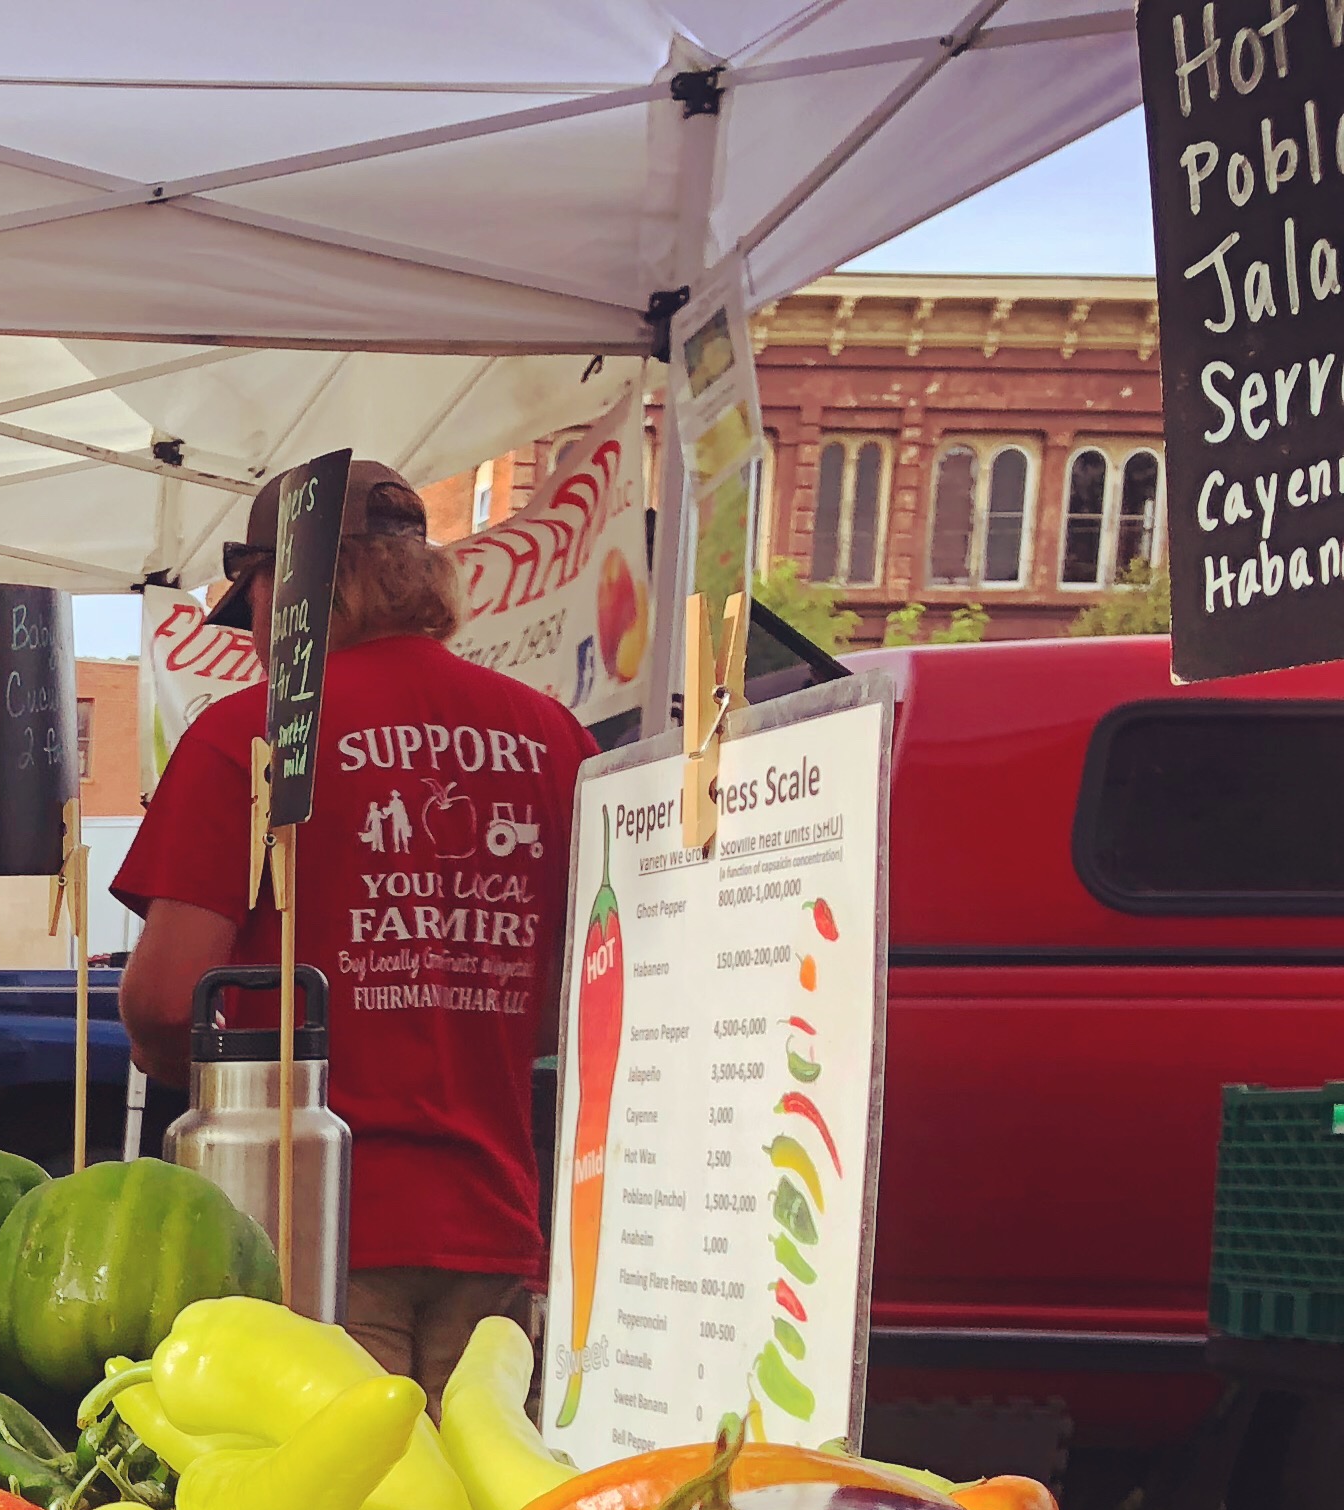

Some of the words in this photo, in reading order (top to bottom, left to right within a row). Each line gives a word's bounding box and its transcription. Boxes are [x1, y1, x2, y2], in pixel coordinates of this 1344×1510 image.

[1172, 0, 1298, 117] Hot
[1184, 217, 1341, 333] Jala
[1201, 353, 1344, 443] Serr
[1204, 537, 1344, 614] Haban
[292, 637, 315, 701] $1
[18, 726, 35, 770] 2
[338, 722, 548, 773] SUPPORT
[616, 798, 675, 845] Pepper
[765, 755, 821, 807] Scale
[720, 838, 756, 858] Scoville
[785, 826, 811, 845] units
[813, 812, 844, 843] (SHU)
[726, 861, 753, 879] function
[753, 861, 762, 873] of
[762, 857, 792, 875] capsaicin
[792, 845, 844, 867] concentration)
[361, 871, 445, 899] YOUR
[636, 902, 659, 919] Ghost
[659, 899, 687, 918] Pepper
[718, 878, 801, 909] 800,000-1,000,000
[349, 906, 540, 948] FARMERS
[369, 948, 420, 979] Locally
[586, 936, 616, 985] HOT
[633, 959, 670, 978] Habanero
[716, 944, 791, 970] 150,000-200,000
[630, 1025, 659, 1042] Serrano
[660, 1024, 690, 1043] Pepper
[714, 1017, 767, 1040] 4,500-6,000
[628, 1065, 661, 1086] Jalapeño
[711, 1062, 765, 1083] 3,500-6,500
[626, 1107, 659, 1126] Cayenne
[709, 1106, 734, 1127] 3,000
[575, 1146, 604, 1185] Mild
[624, 1148, 637, 1164] Hot
[639, 1149, 657, 1165] Wax
[707, 1150, 731, 1170] 2,500
[622, 1187, 653, 1206] Poblano
[654, 1189, 687, 1212] (Ancho)
[704, 1192, 757, 1215] 1,500-2,000
[620, 1228, 654, 1247] Anaheim
[703, 1235, 729, 1256] 1,000
[619, 1267, 649, 1292] Flaming
[649, 1271, 669, 1291] Flare
[670, 1274, 698, 1294] Fresno
[700, 1278, 745, 1301] 800-1,000
[617, 1308, 668, 1331] Pepperoncini
[699, 1321, 736, 1342] 100-500
[555, 1333, 610, 1381] Sweet
[615, 1348, 653, 1371] Cubanelle
[697, 1363, 704, 1379] 0
[614, 1387, 637, 1408] Sweet
[638, 1393, 669, 1415] Banana
[696, 1404, 703, 1422] 0
[612, 1427, 627, 1446] Bell
[627, 1431, 656, 1453] Pepper
